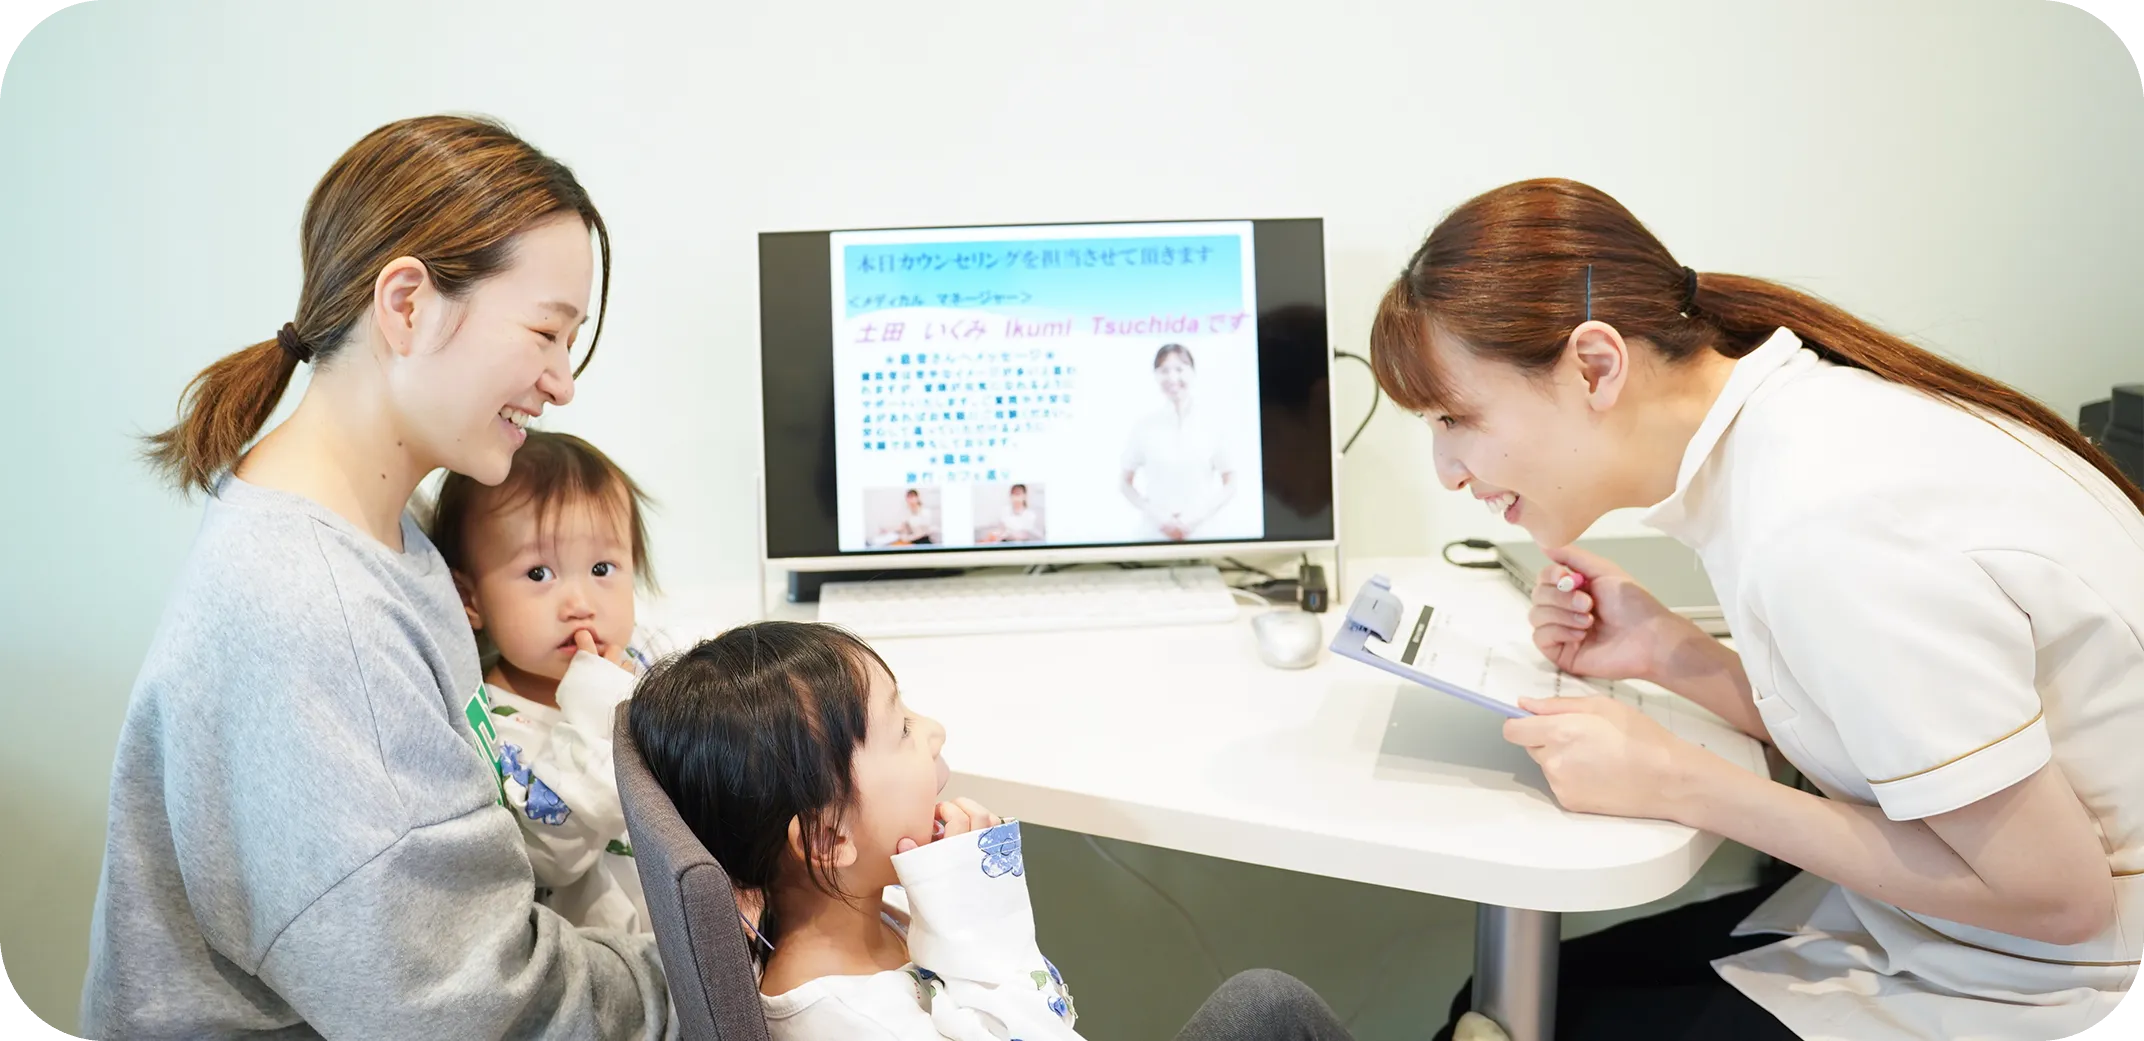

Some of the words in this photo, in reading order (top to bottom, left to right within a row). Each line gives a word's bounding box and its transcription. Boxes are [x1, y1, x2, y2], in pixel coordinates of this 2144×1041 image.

[855, 319, 905, 344] 土田
[923, 318, 988, 339] いくみ
[1004, 316, 1072, 337] Ikumi
